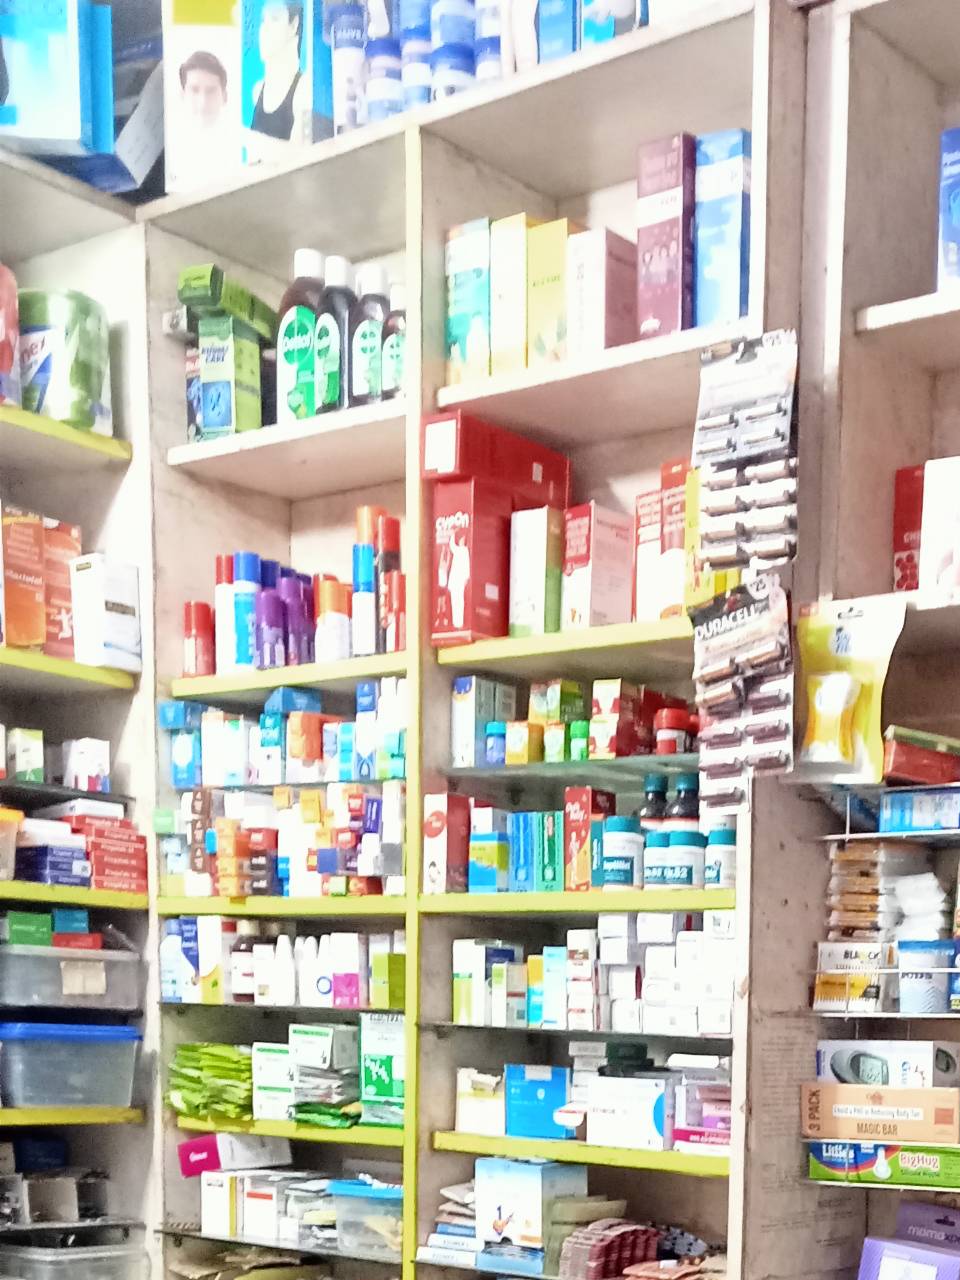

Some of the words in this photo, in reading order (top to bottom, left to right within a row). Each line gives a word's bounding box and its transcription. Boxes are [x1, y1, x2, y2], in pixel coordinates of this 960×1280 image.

[695, 604, 757, 640] DURACELL
[808, 1089, 820, 1116] PACK
[857, 1123, 881, 1136] MAGIC
[882, 1123, 898, 1136] BAR
